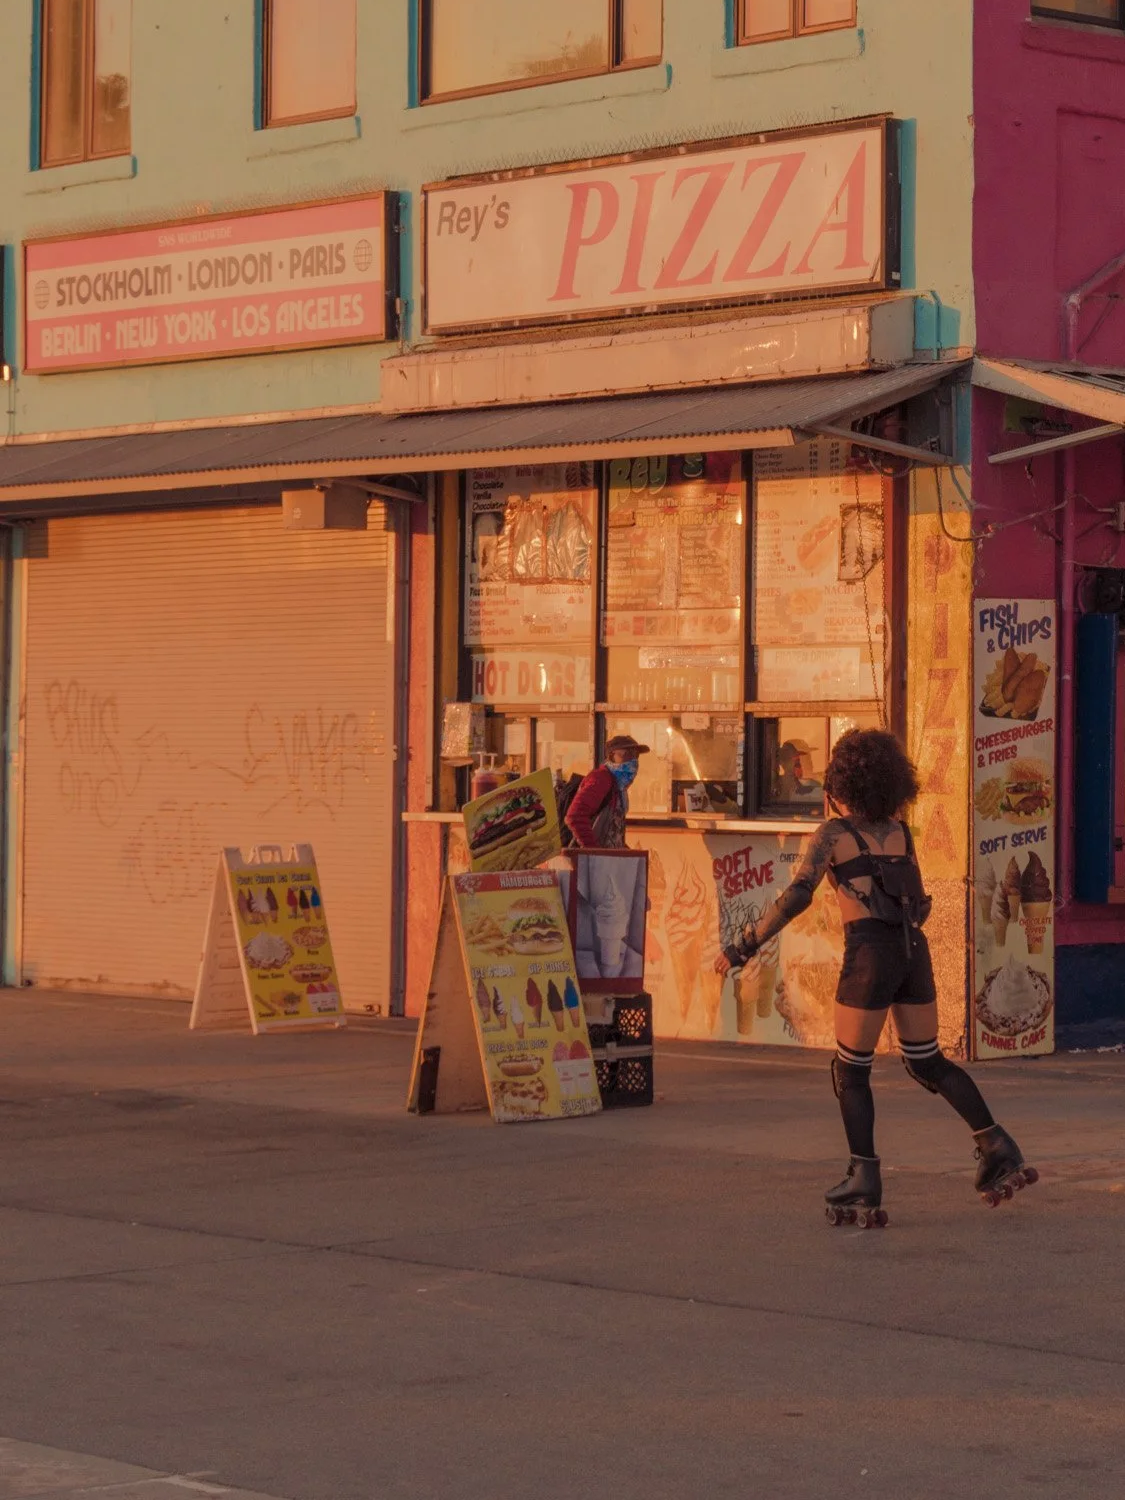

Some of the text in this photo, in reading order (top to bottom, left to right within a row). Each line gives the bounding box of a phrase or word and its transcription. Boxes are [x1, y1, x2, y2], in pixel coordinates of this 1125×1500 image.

[437, 194, 511, 242] Rey's
[547, 140, 870, 301] PIZZA
[177, 227, 233, 244] WORLDWIDE
[56, 242, 346, 307] STOCKHOLM LONDON PARIS
[41, 293, 364, 358] BERLIN NEW YORK LOS ANGELES
[979, 601, 1018, 632] FISH
[986, 615, 1052, 653] & CHIPS
[474, 660, 510, 697] HOT
[975, 718, 1053, 751] CHEESEBURGER
[977, 745, 1018, 768] & FRIES
[980, 825, 1047, 855] SOFT SERVE
[712, 846, 752, 880] SOFT
[723, 860, 774, 898] SERVE
[500, 875, 553, 888] HAMBURGERS
[1019, 916, 1052, 926] CHOCOLATE
[981, 1025, 1047, 1050] FUNNEL CAKE
